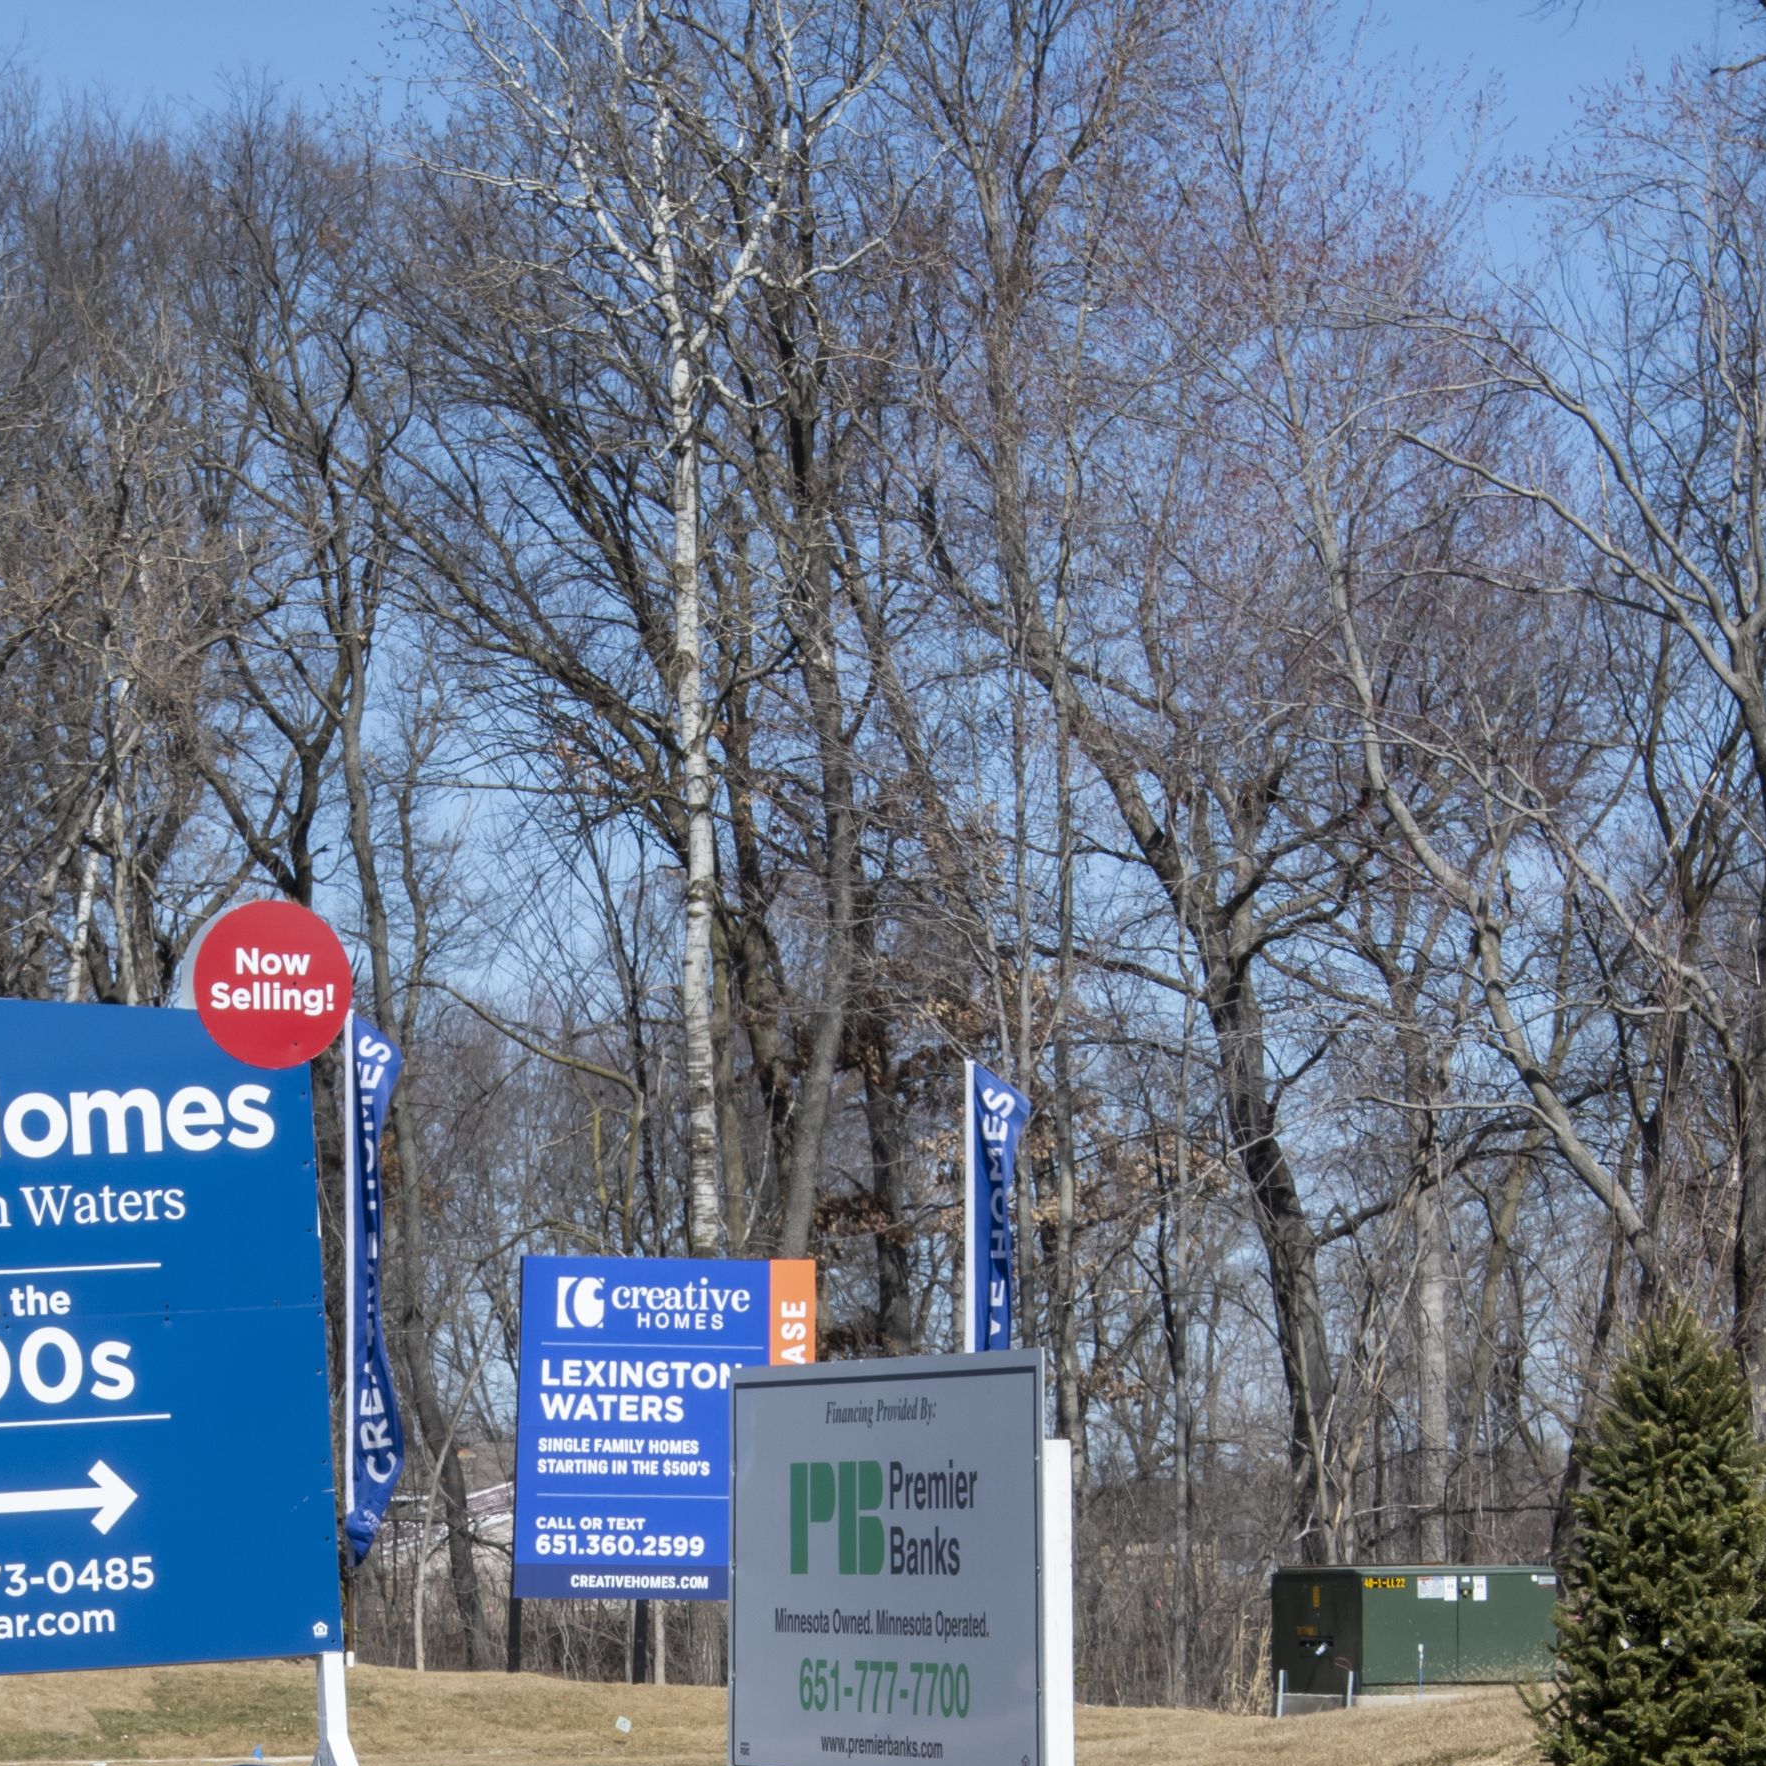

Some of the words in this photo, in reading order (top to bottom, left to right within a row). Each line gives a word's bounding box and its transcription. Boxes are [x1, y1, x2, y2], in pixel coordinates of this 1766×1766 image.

[235, 947, 311, 977] Now
[210, 981, 335, 1017] Selling!
[20, 1184, 186, 1226] Waters
[10, 1285, 71, 1317] the
[611, 1276, 751, 1312] creative
[637, 1312, 724, 1331] HOMES
[780, 1301, 807, 1365] ASE
[541, 1359, 743, 1390] LEXINGTON
[540, 1393, 685, 1423] WATERS
[825, 1400, 873, 1428] Financing
[876, 1397, 918, 1422] Provided
[920, 1397, 937, 1425] By:
[538, 1437, 590, 1453] SINGLE
[594, 1438, 645, 1454] FAMILY
[649, 1439, 699, 1455] HOMES
[537, 1458, 608, 1474] STARTING
[612, 1460, 628, 1475] IN
[632, 1460, 659, 1475] THE
[663, 1459, 710, 1477] $500'S
[889, 1459, 977, 1510] Premier
[536, 1516, 575, 1530] CALL
[580, 1517, 602, 1530] OR
[607, 1517, 646, 1531] TEXT
[535, 1534, 705, 1557] 651.360.2599
[890, 1526, 960, 1576] Banks
[570, 1574, 709, 1589] CREATIVEHOMES.COM
[774, 1607, 829, 1633] Minnesota
[832, 1608, 873, 1635] Owned.
[876, 1609, 932, 1637] Minnesota
[935, 1610, 990, 1643] Operated.
[799, 1656, 970, 1719] 651-777-7700
[821, 1734, 943, 1759] www.premierbanks.com
